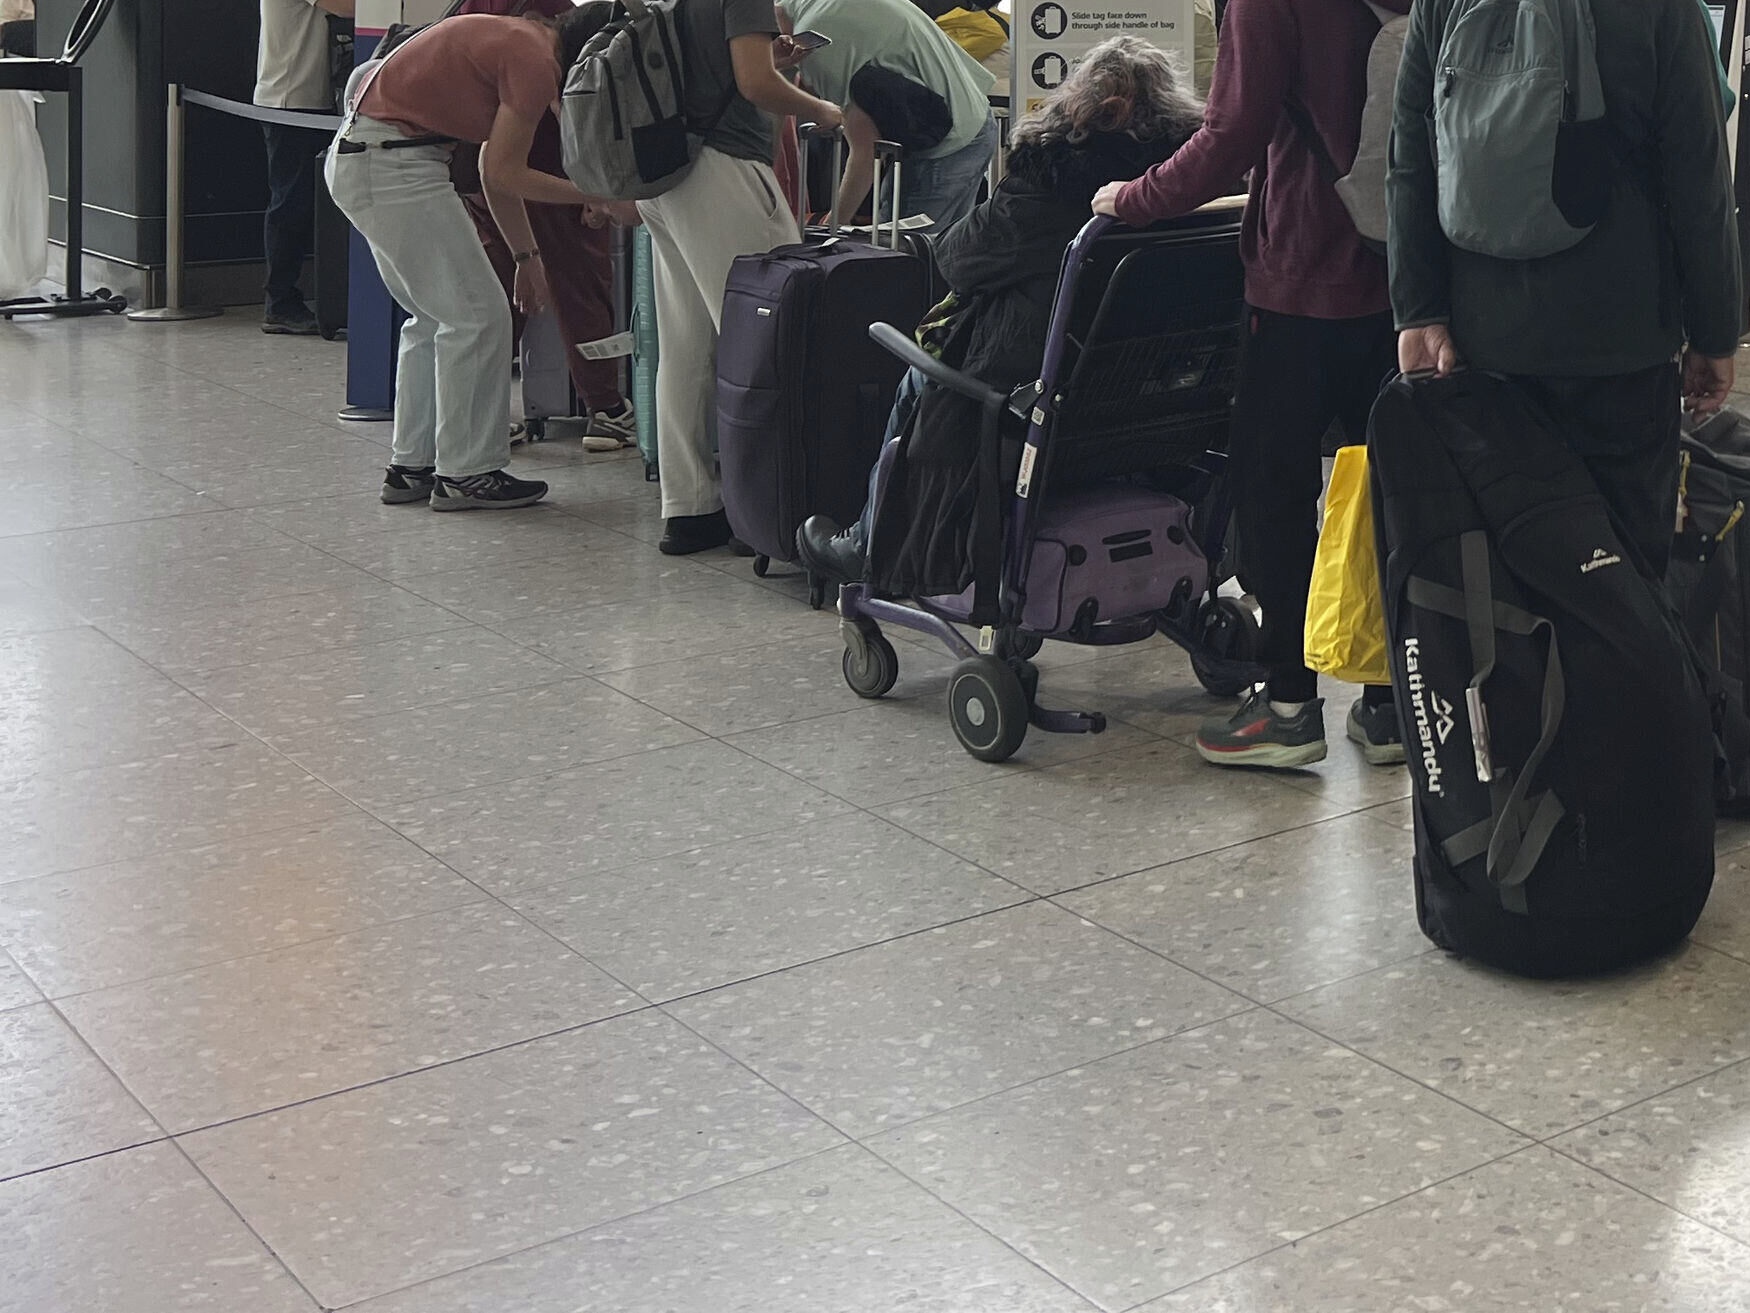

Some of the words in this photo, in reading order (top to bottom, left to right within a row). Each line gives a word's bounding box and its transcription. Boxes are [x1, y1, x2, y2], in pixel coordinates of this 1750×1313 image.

[1093, 13, 1105, 21] tag
[1072, 22, 1101, 31] through
[1161, 22, 1175, 30] bag
[1404, 637, 1442, 793] Kathmandu
